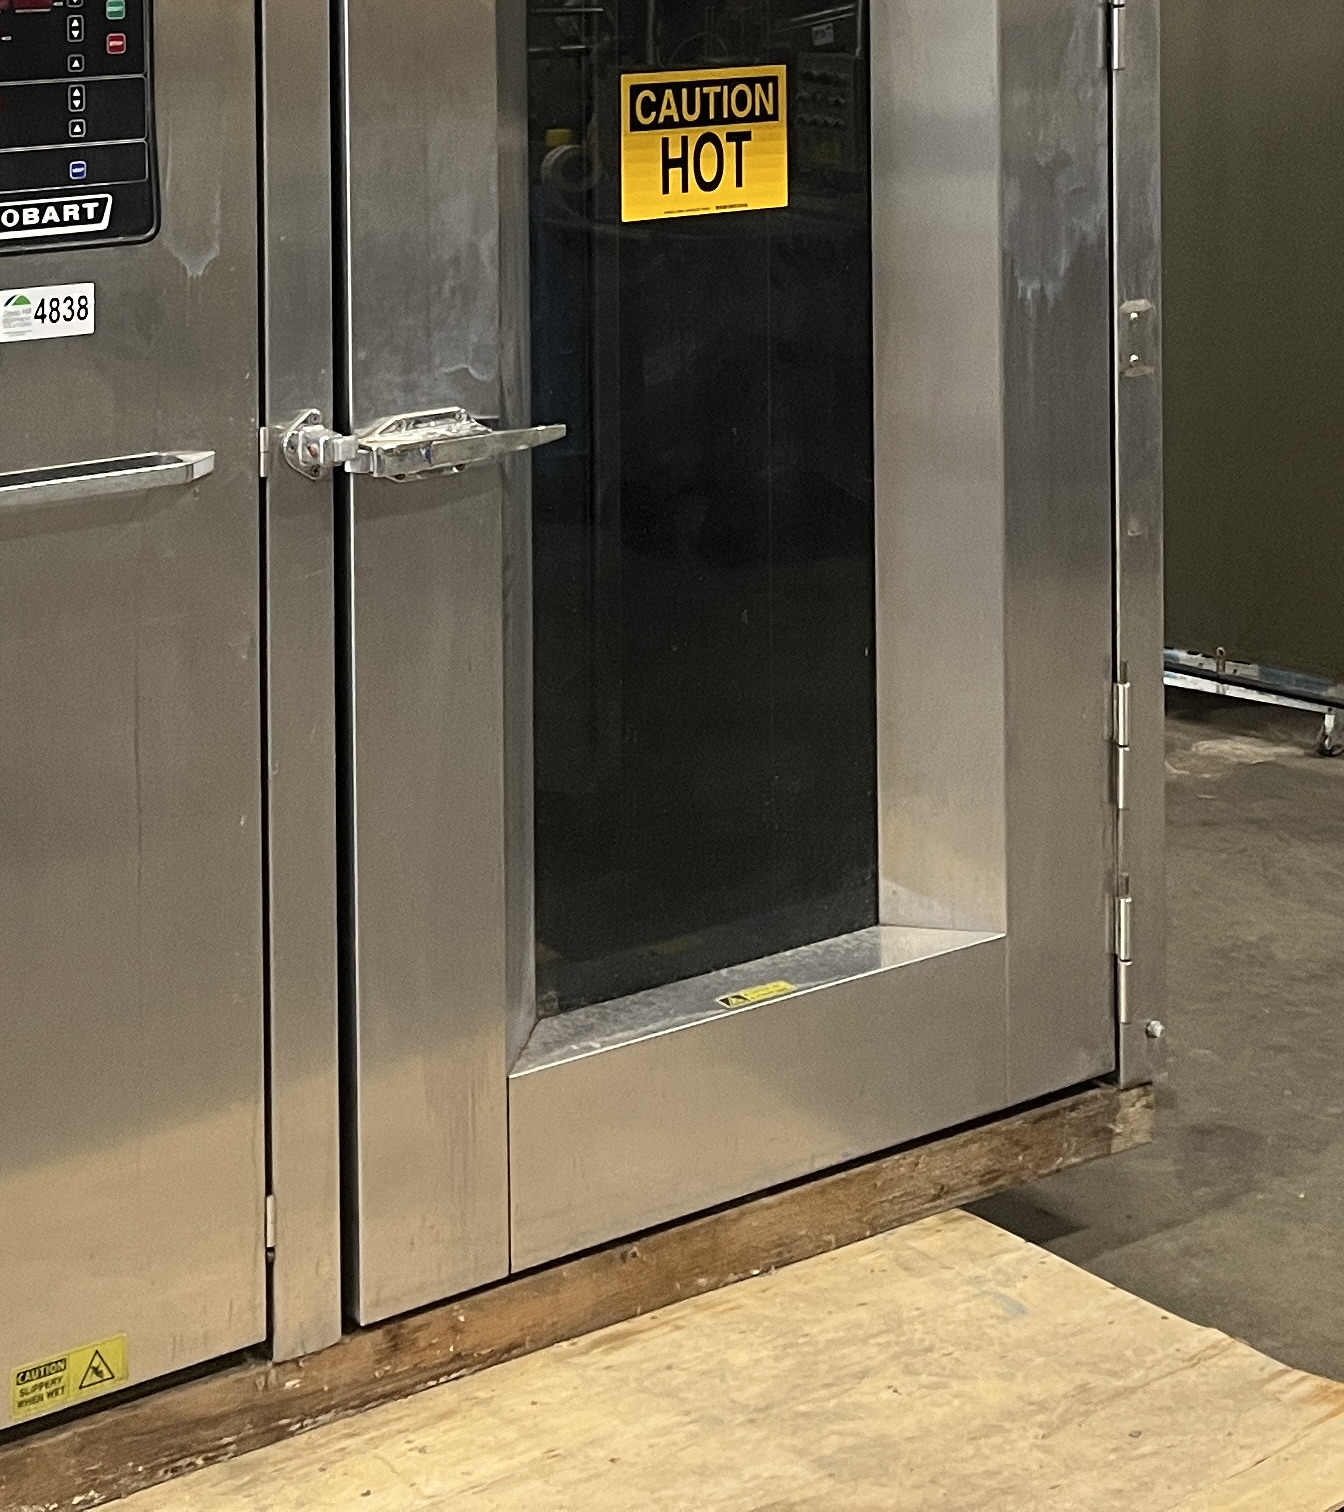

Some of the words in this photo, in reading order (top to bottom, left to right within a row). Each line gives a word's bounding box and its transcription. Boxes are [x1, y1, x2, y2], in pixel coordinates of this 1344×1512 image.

[635, 82, 774, 125] CAUTION
[661, 130, 752, 195] HOT
[33, 295, 89, 324] 4838
[17, 1360, 65, 1385] CAUTION
